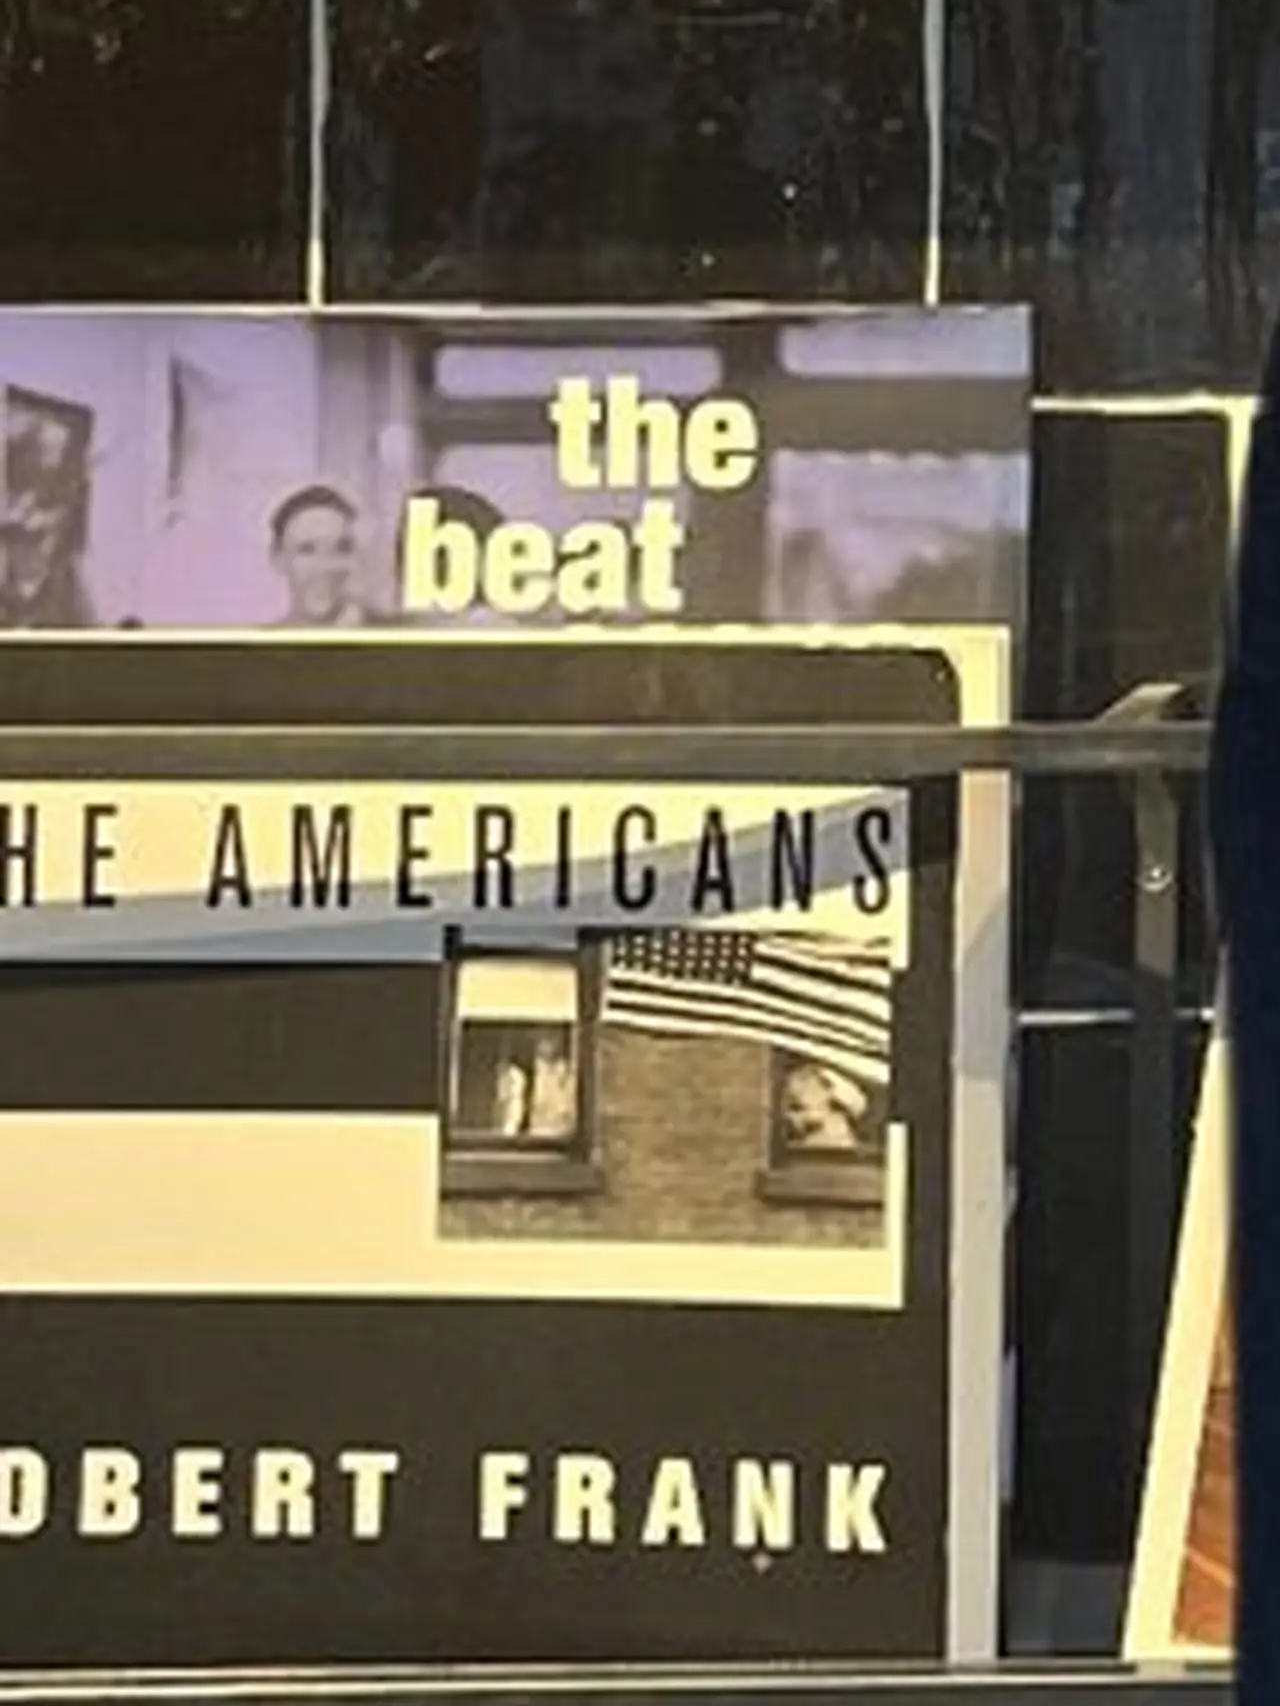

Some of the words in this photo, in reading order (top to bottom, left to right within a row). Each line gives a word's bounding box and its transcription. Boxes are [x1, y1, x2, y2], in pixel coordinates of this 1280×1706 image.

[550, 376, 757, 490] the
[403, 498, 684, 612] beat
[0, 803, 118, 908] HE
[208, 803, 893, 917] AMERICANS
[0, 1447, 399, 1541] OBERT
[480, 1451, 889, 1555] FRANK
